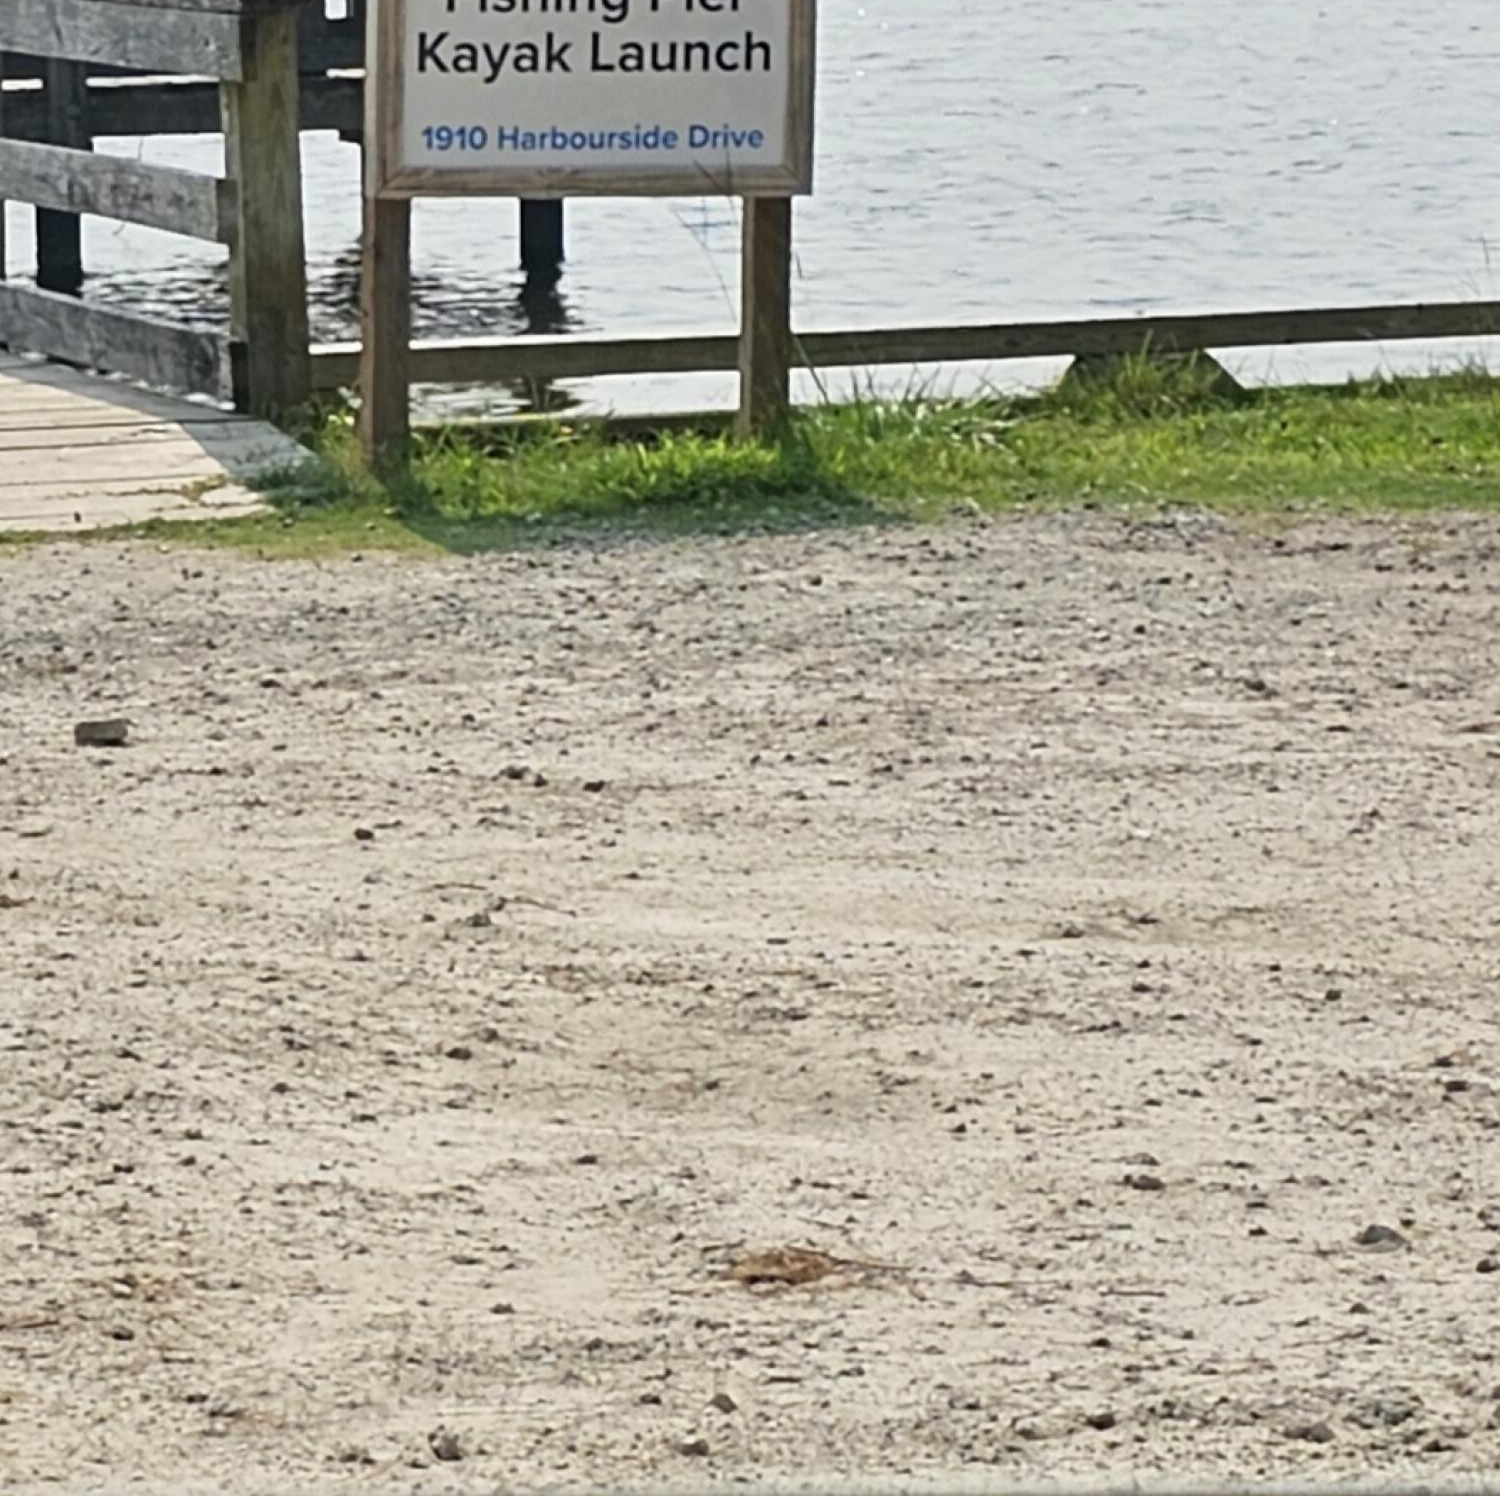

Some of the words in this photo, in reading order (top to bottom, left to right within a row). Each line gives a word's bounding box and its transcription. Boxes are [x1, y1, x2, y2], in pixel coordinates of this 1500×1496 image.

[418, 32, 572, 83] Kayak
[590, 31, 771, 72] Launch
[422, 127, 488, 150] 1910
[498, 125, 677, 150] Harbourside
[688, 125, 763, 149] Drive
